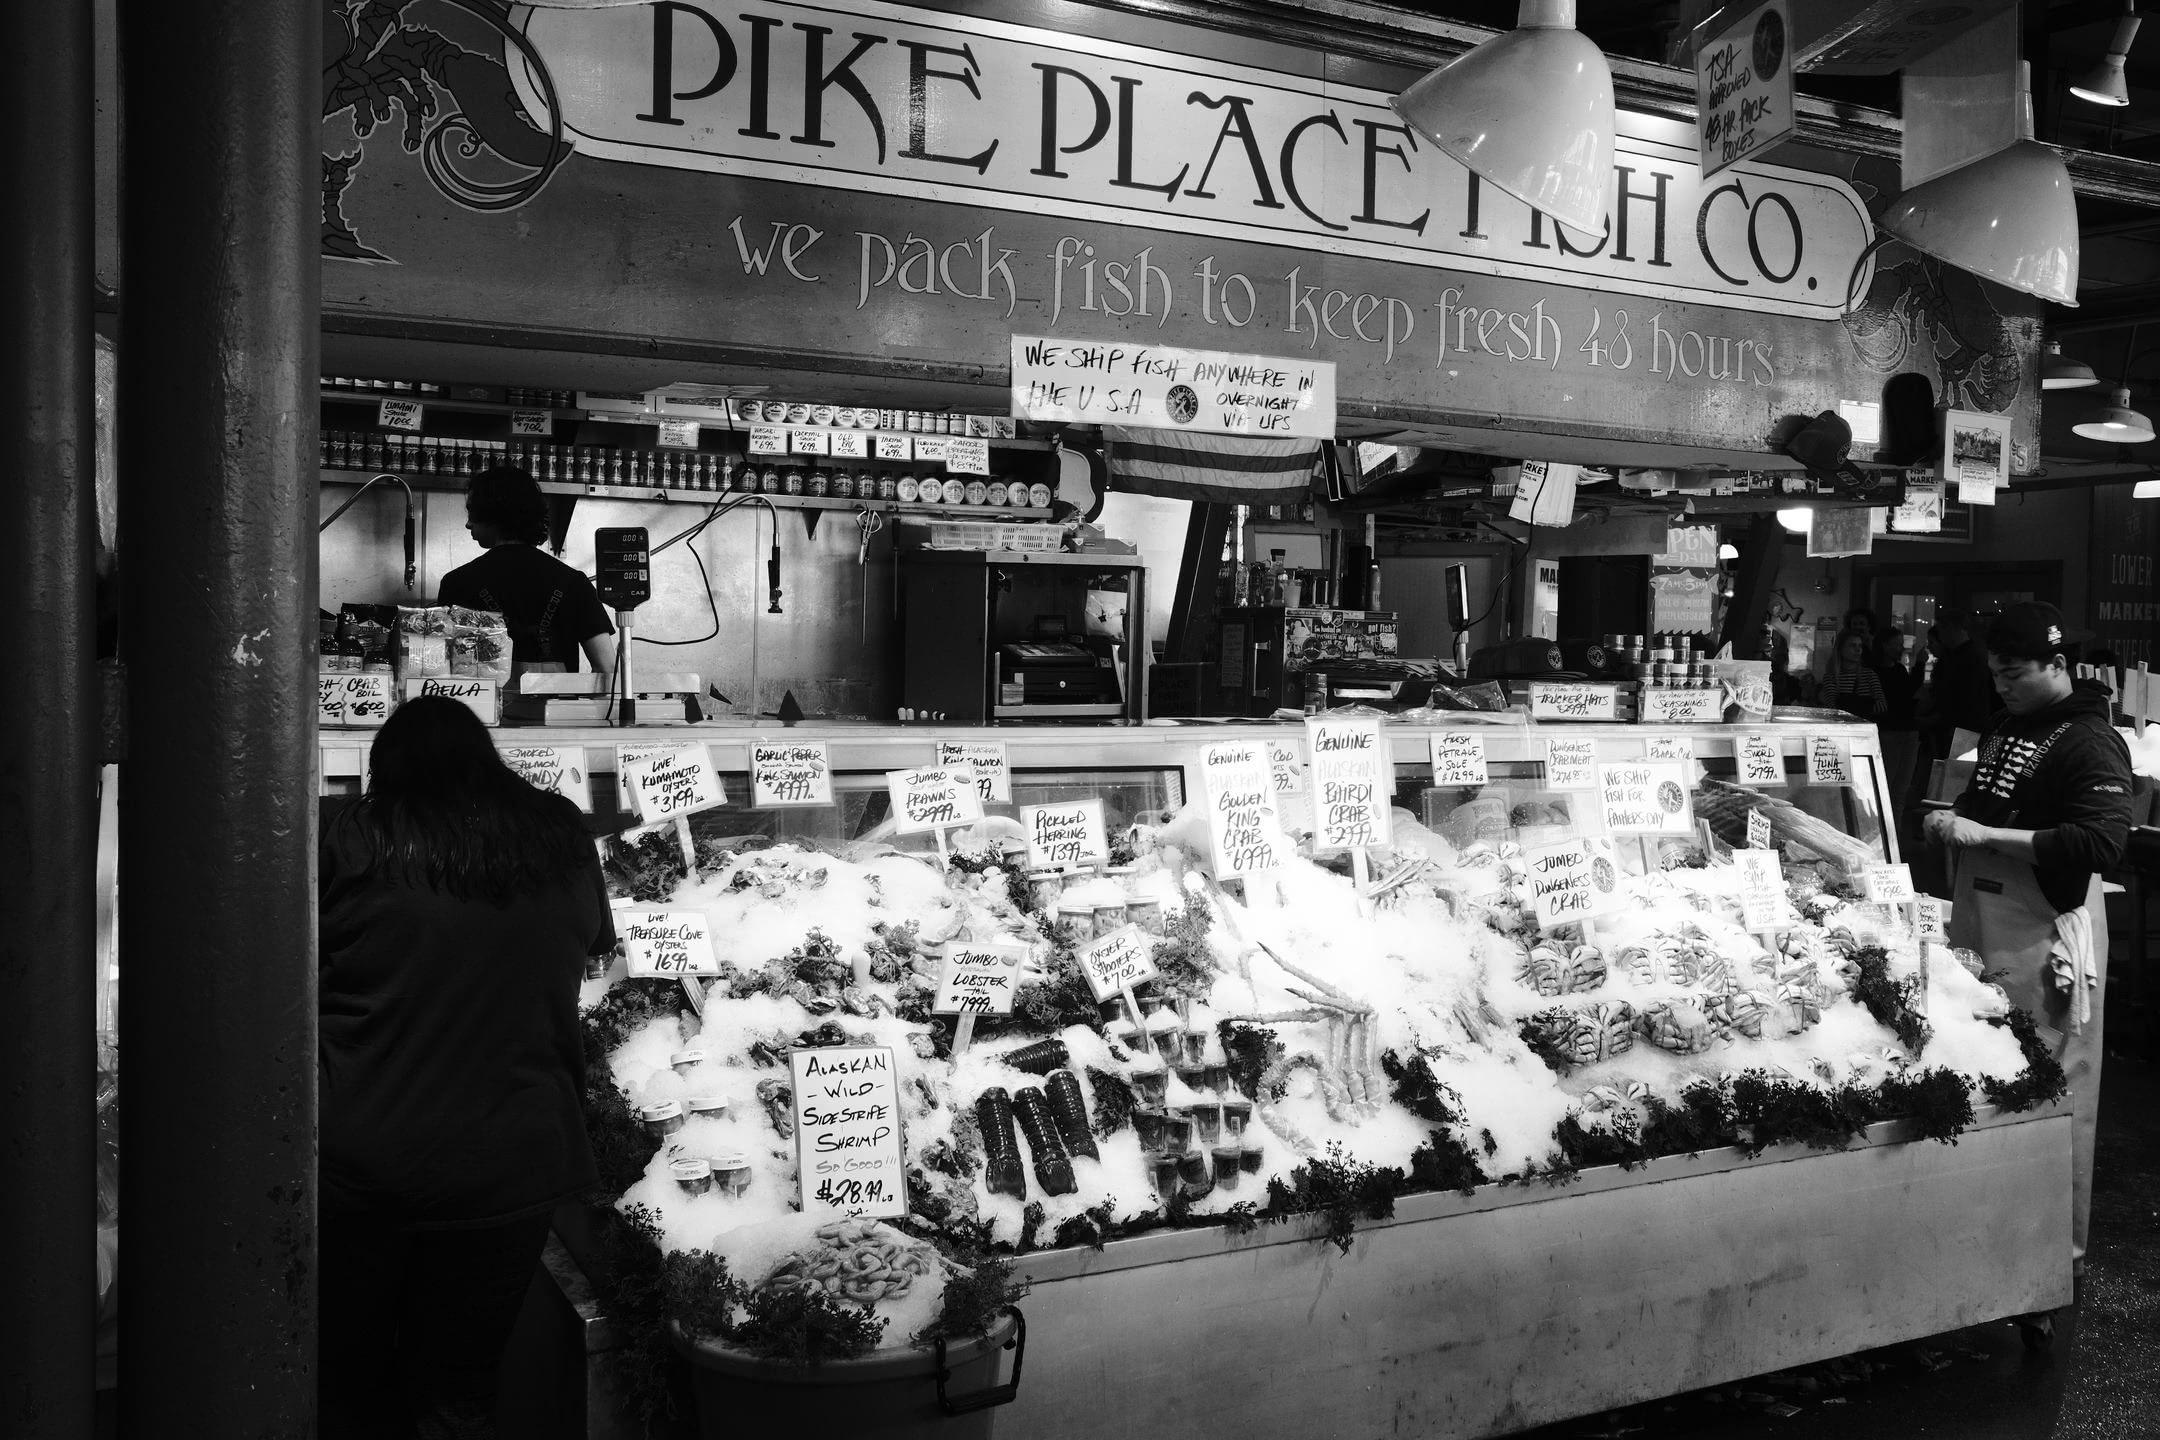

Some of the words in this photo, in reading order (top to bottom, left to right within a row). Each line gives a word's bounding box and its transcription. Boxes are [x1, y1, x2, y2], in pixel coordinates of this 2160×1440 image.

[1705, 43, 1742, 90] TSA
[1709, 67, 1751, 110] APPROVED
[636, 1, 999, 175] PIKE
[1030, 61, 1431, 237] PLACE
[1705, 114, 1721, 151] 48
[1739, 95, 1772, 132] PACK
[1722, 128, 1755, 162] BOXES
[1697, 178, 1818, 291] CO.
[728, 215, 824, 282] we
[855, 225, 1019, 318] pack
[1049, 236, 1173, 329] fish
[1193, 243, 1258, 328] to
[1284, 265, 1416, 366] keep
[1433, 284, 1563, 371] fresh
[1578, 309, 1632, 371] 48
[1650, 311, 1776, 389] hours
[1025, 340, 1060, 367] WE
[1065, 347, 1125, 374] SHIP
[1189, 361, 1290, 388] ANYWHERE
[1028, 380, 1073, 410] THE
[1216, 391, 1300, 411] OVERNIGHT
[1259, 412, 1291, 431] UPS
[2112, 554, 2152, 586] LOWER
[1368, 624, 1379, 634] got
[1380, 623, 1397, 634] fish?
[347, 678, 381, 692] CRAB
[356, 689, 382, 698] BOIL
[421, 679, 489, 698] PAELLA
[1536, 694, 1583, 705] TRUCKER
[1584, 693, 1609, 706] HATS
[1653, 698, 1710, 710] SEASONINGS
[1315, 727, 1376, 753] GENUINE
[1550, 739, 1592, 753] DUNGENESS
[507, 754, 562, 769] SALMON
[508, 746, 556, 758] SMOKED
[1207, 747, 1256, 767] GENUINE
[1273, 748, 1294, 763] COD
[1438, 745, 1481, 761] PETRALE
[1739, 747, 1776, 760] SWORD
[1446, 759, 1468, 771] SOLE
[1813, 756, 1845, 769] TUNA
[642, 764, 701, 790] KUMAMOTO
[662, 775, 699, 794] OYSTERS
[755, 768, 780, 784] KING
[780, 768, 821, 781] SALMON
[905, 771, 948, 785] JUMBO
[1604, 768, 1622, 787] WE
[1623, 769, 1652, 785] SHIP
[906, 788, 957, 809] PRAWNS
[1219, 784, 1268, 812] GOLDEN
[1603, 786, 1624, 803] FISH
[1627, 786, 1647, 803] FOR
[1036, 809, 1087, 830] PICKLED
[1227, 807, 1261, 828] KING
[1329, 804, 1370, 826] CRAB
[1646, 811, 1665, 830] DAY
[1032, 826, 1088, 845] HERRING
[1223, 828, 1264, 850] CRAB
[1532, 853, 1584, 873] JUMBO
[1534, 871, 1592, 898] DUNGENESS
[1551, 890, 1593, 916] CRAB
[626, 924, 679, 941] TREASURE
[679, 923, 705, 940] COVE
[654, 940, 689, 953] OYSTERS
[1090, 937, 1129, 966] OYSTER
[952, 949, 998, 967] JUMBO
[1092, 946, 1143, 978] SHOOTERS
[952, 972, 1009, 990] LOBSTER
[964, 986, 990, 996] TAIL
[805, 1052, 888, 1078] ALASKAN
[824, 1079, 875, 1099] WILD
[815, 1126, 891, 1153] SHRIMP
[815, 1159, 841, 1175] SO
